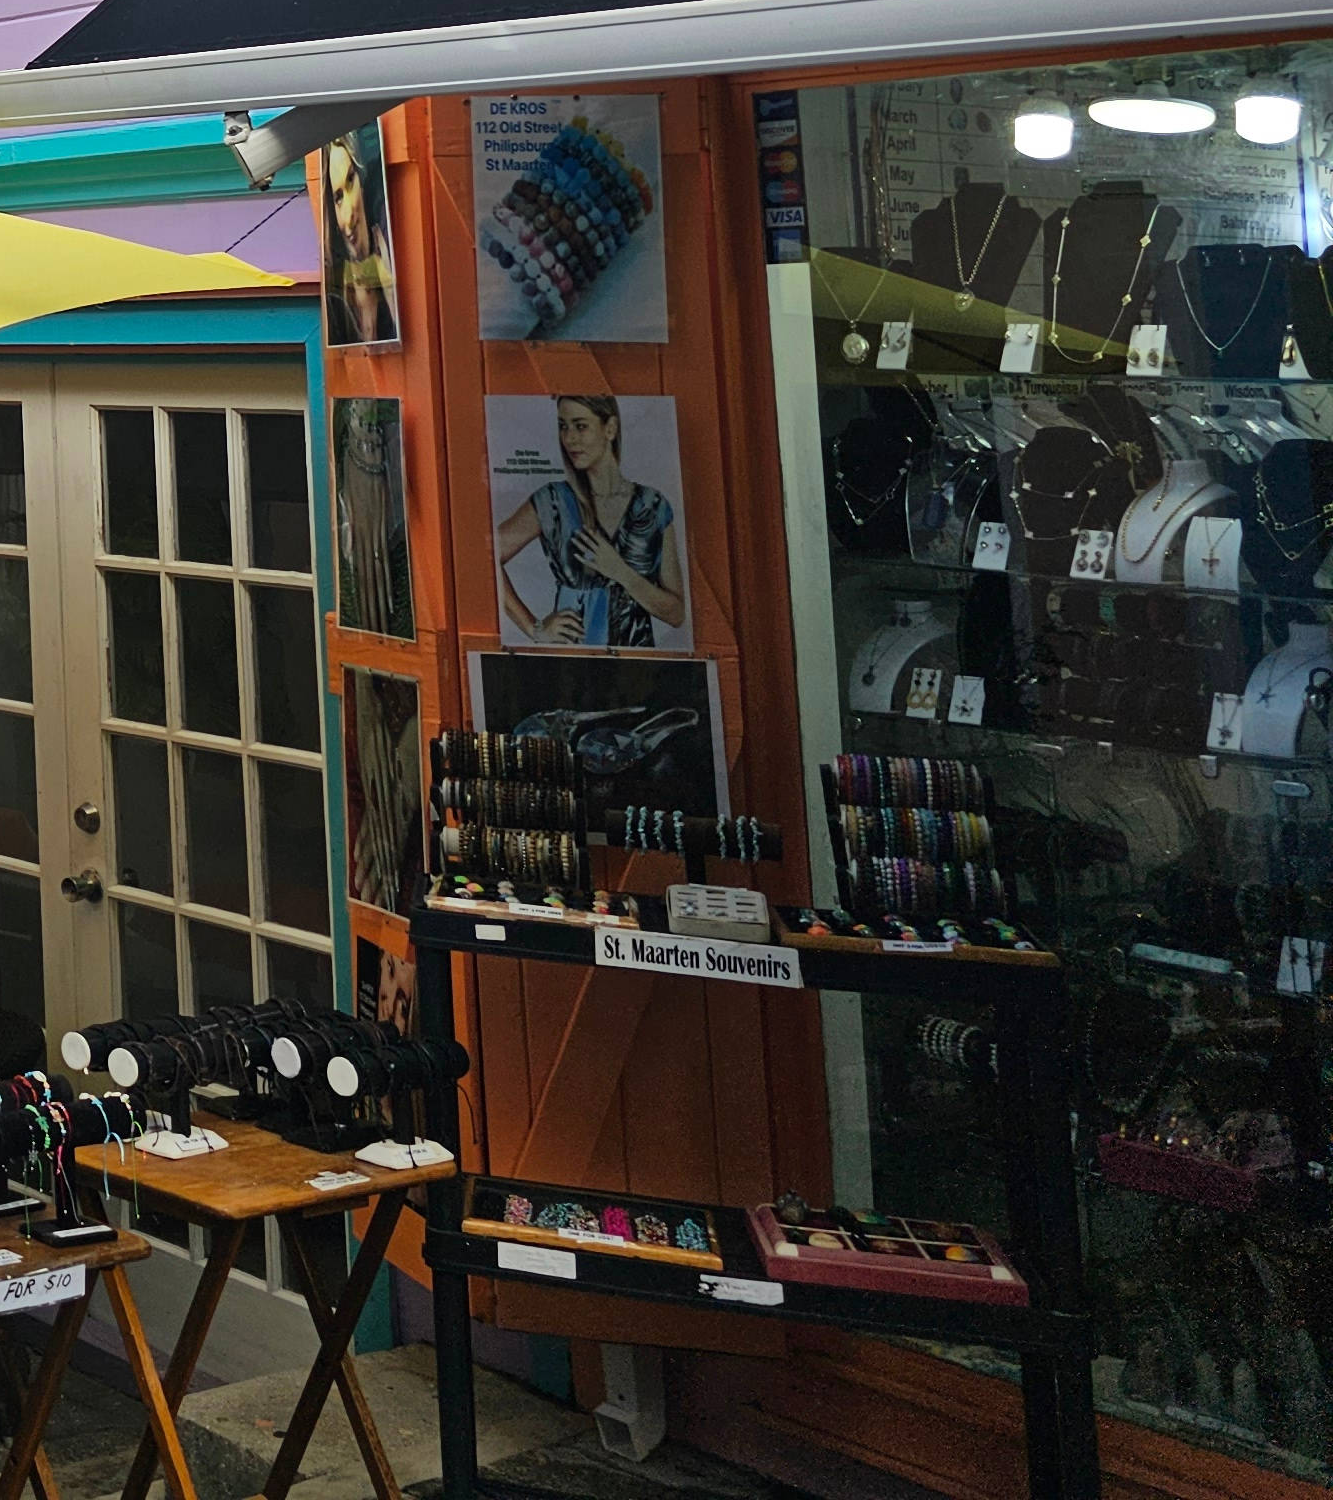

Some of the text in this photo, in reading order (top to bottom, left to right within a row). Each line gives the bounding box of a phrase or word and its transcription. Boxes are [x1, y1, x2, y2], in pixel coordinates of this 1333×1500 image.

[490, 102, 547, 115] DE KROS
[476, 121, 563, 134] 112 Old Street
[887, 136, 916, 155] April
[486, 159, 500, 171] St
[889, 166, 915, 185] May
[890, 199, 919, 213] June
[769, 210, 803, 224] VISA
[893, 226, 909, 240] Ju
[604, 934, 791, 981] St. Maarten Souvenirs
[3, 1279, 36, 1301] FOR
[44, 1273, 72, 1291] $10
